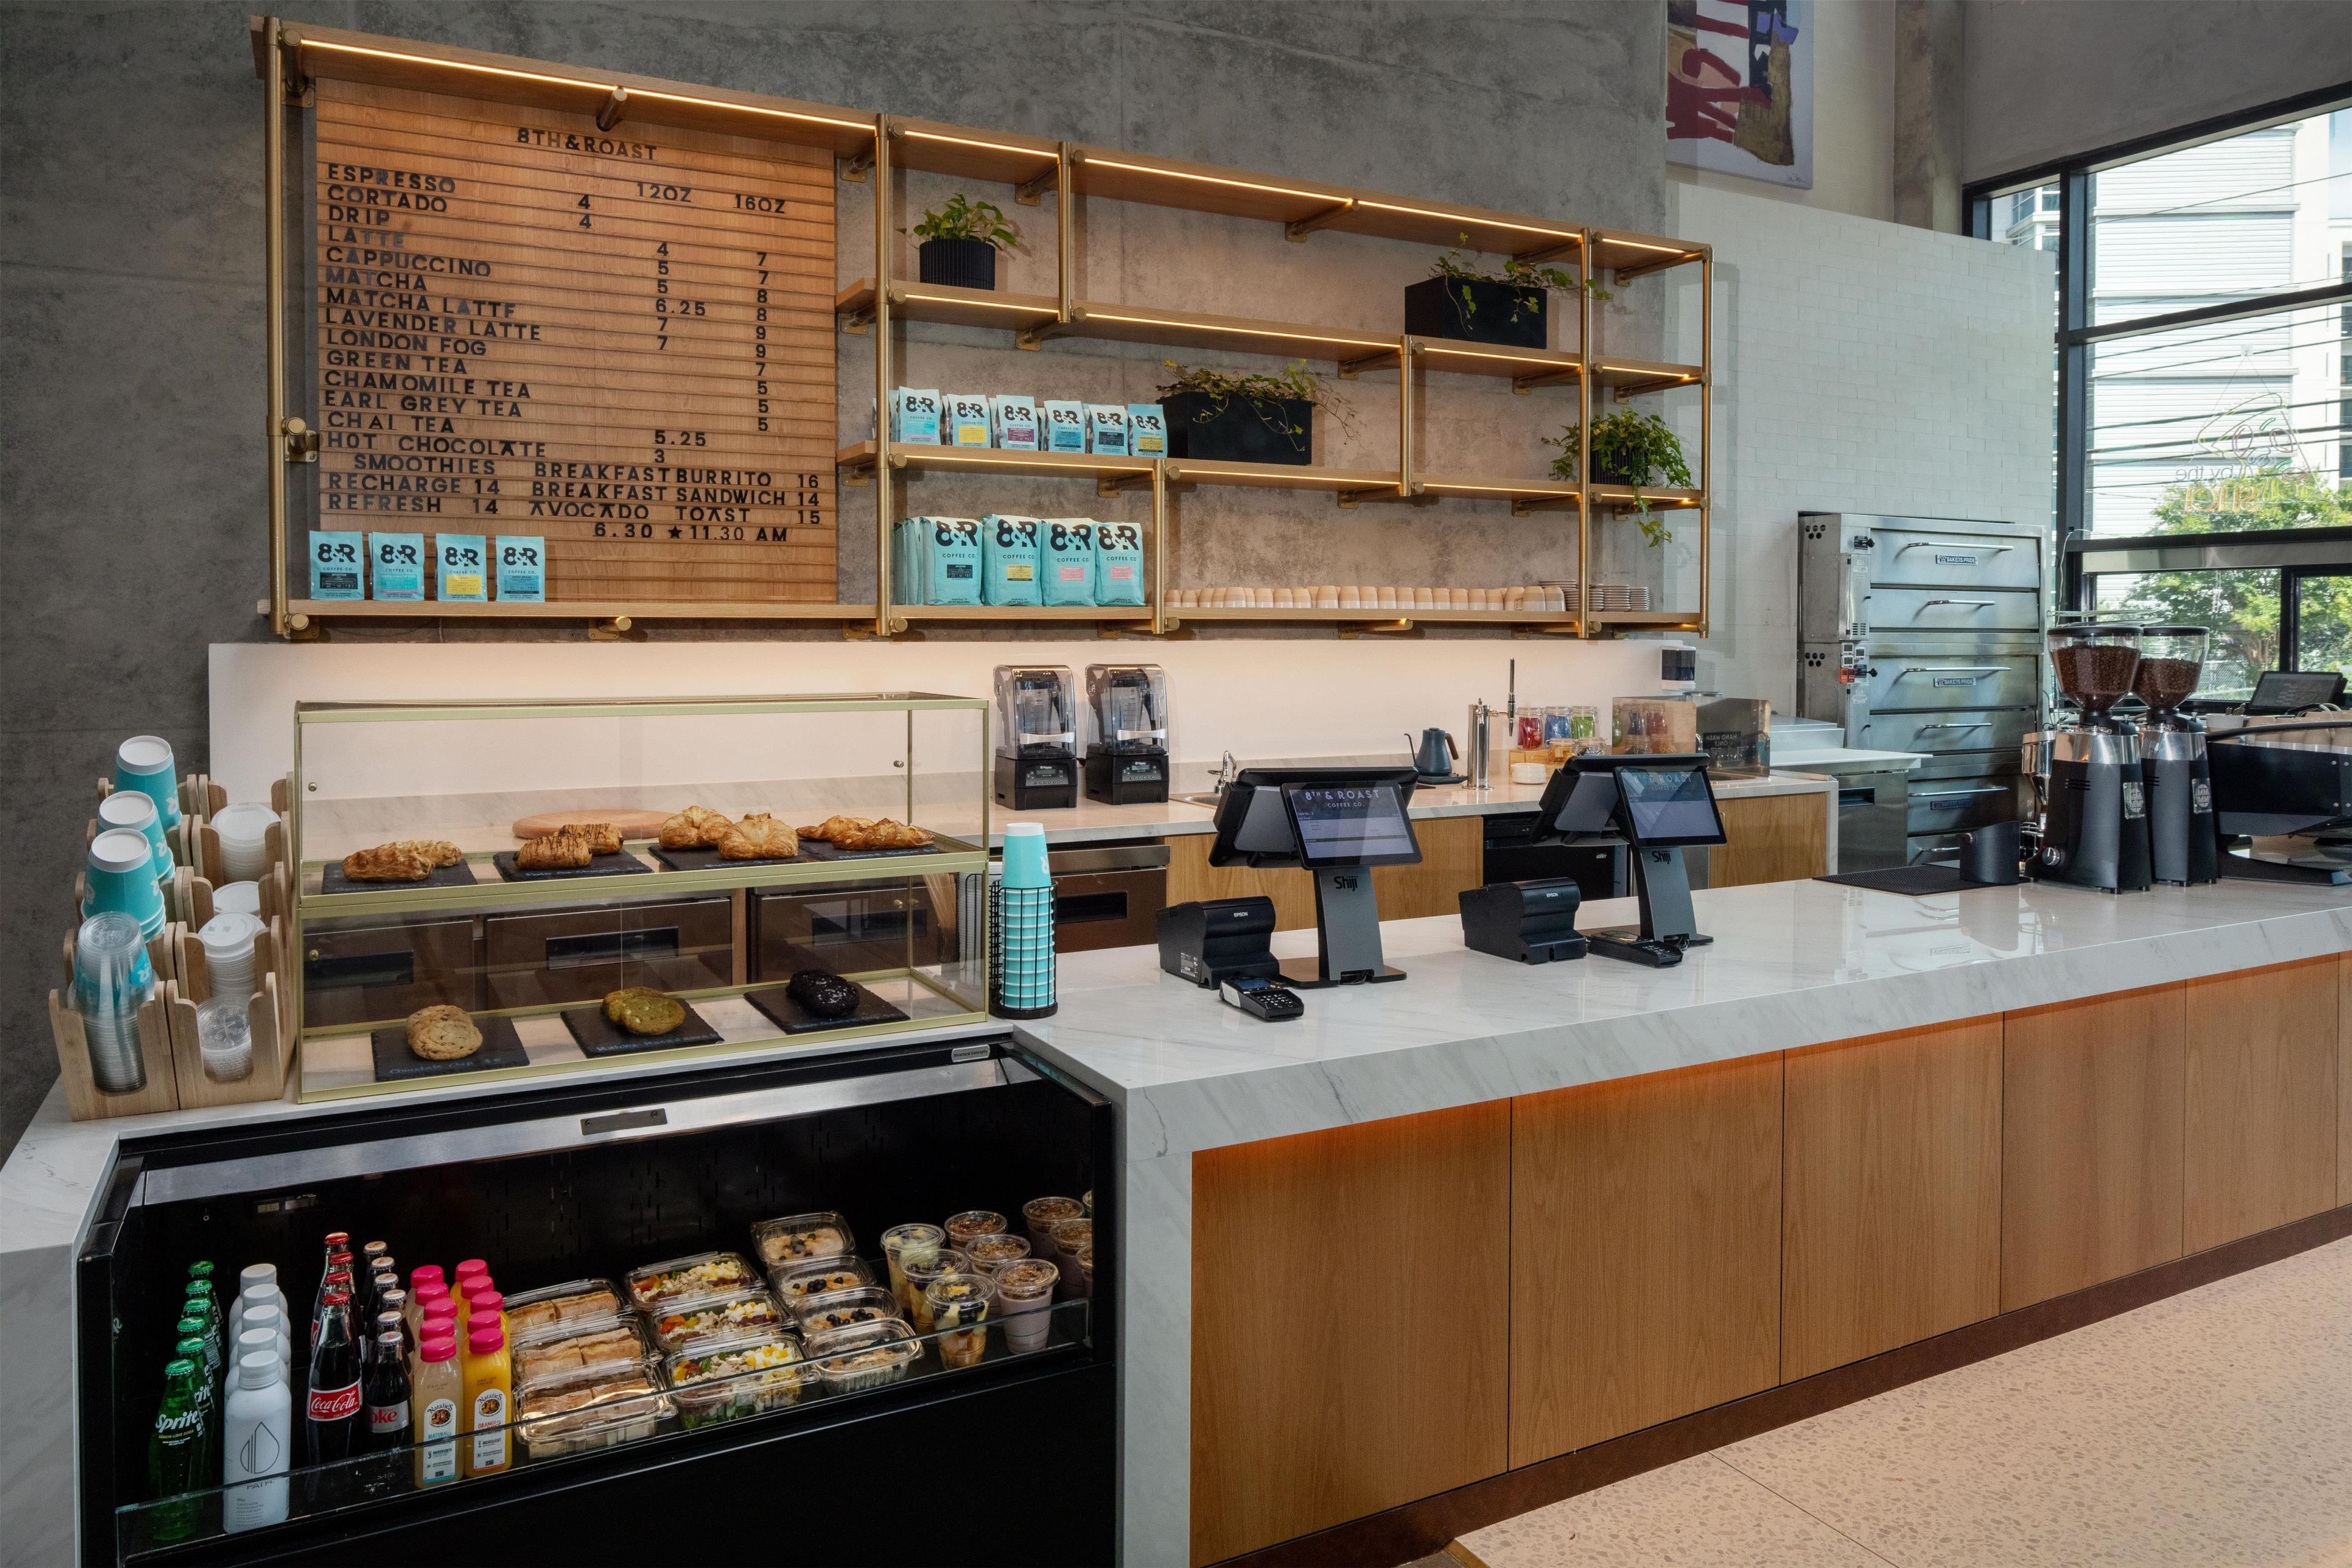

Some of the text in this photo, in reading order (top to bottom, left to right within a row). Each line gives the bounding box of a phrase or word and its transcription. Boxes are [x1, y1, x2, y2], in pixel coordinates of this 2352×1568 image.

[517, 127, 657, 160] 8TH&ROAST
[328, 163, 590, 209] ESPRESSO 4
[636, 181, 786, 214] 12OZ 16OZ
[328, 184, 592, 229] CORTADO 4
[329, 205, 767, 266] DRIP 4 7
[329, 227, 769, 285] LATTE 5 7
[326, 247, 768, 304] CAPPUCCINO 5 8
[326, 266, 767, 322] MATCHA 6.25 8
[326, 288, 766, 341] MATCHA LATTE 7 9
[326, 307, 766, 358] LAVENDER LATTE 7 9
[328, 328, 766, 377] LONDON FOG 7
[327, 350, 767, 395] GREEN TEA 5
[325, 371, 769, 413] CHAMOMILE TEA 5
[325, 390, 768, 432] EARL GREY TEA 5
[328, 411, 706, 447] CHAI TEA 5.25
[328, 432, 665, 463] HOT CHOCOLATE 3
[355, 453, 496, 475] SMOOTHIES
[329, 472, 500, 494] RECHARGE 14
[535, 462, 819, 488] BREAKFAST BURRITO 16
[329, 492, 498, 514] REFRESH 14
[533, 482, 819, 507] BREAKFAST SANDWICH 14
[530, 500, 820, 525] AVOCADO TOAST 15
[594, 522, 787, 542] 6.30 11.30 AM
[1325, 791, 1333, 800] &
[1338, 790, 1379, 800] ROAST
[1659, 774, 1691, 783] ROAST
[1652, 850, 1672, 864] Shiji
[1333, 876, 1359, 892] Shiji
[311, 1390, 356, 1413] Coca-Cola
[155, 1411, 198, 1433] Sprite
